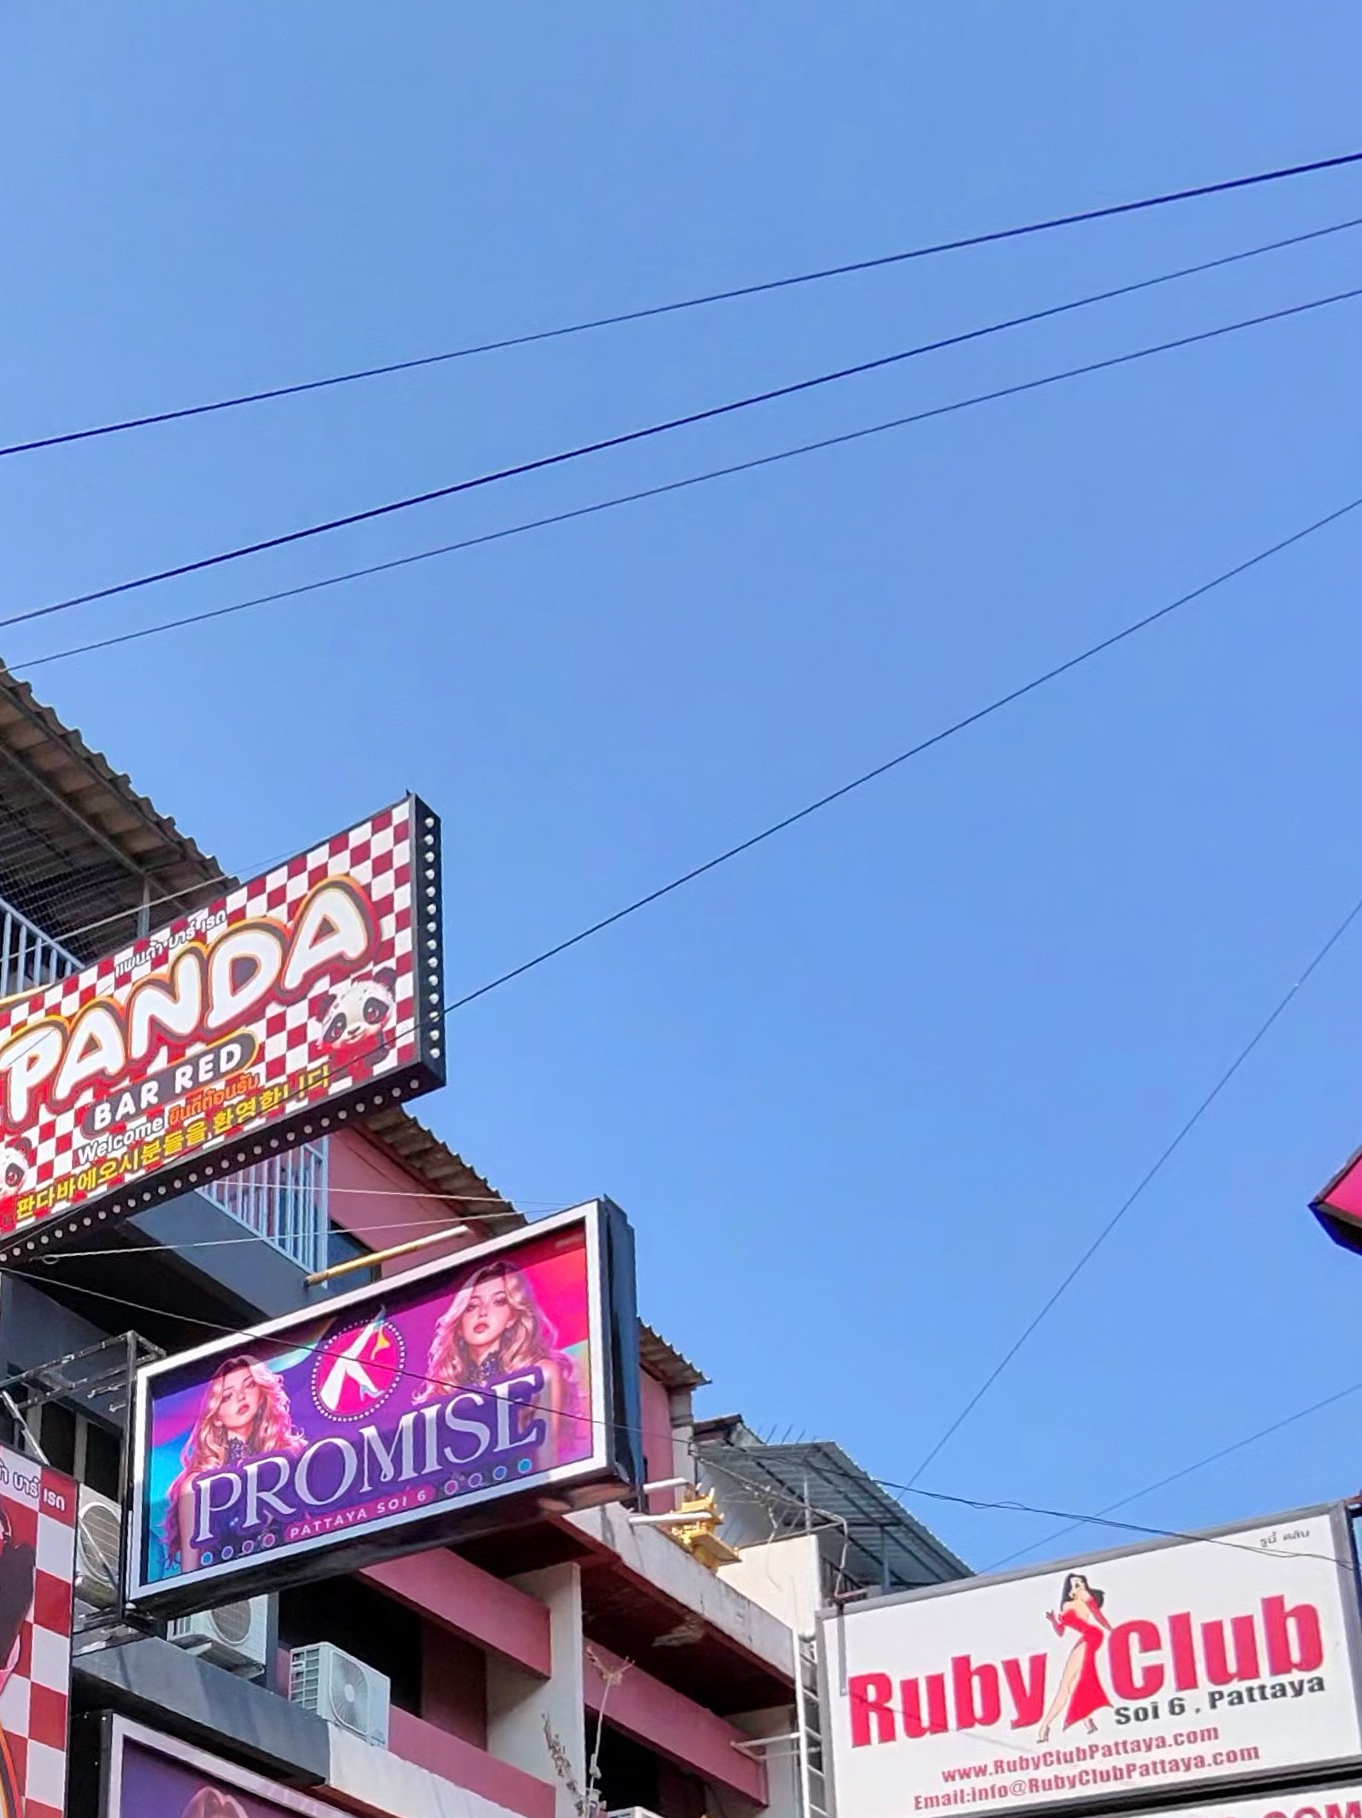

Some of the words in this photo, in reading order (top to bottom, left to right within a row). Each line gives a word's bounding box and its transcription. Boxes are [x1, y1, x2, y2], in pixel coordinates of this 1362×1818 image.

[93, 1081, 159, 1131] BAR
[174, 1042, 242, 1094] RED
[77, 1115, 165, 1166] Welcome
[194, 1374, 539, 1543] PROMISE
[289, 1506, 367, 1539] PATTAYA
[376, 1498, 408, 1517] SOI
[416, 1490, 427, 1504] 6
[847, 1653, 1048, 1748] Ruby
[1107, 1593, 1325, 1702] Club
[1114, 1696, 1159, 1727] Soi
[1208, 1675, 1326, 1713] Pattaya
[941, 1726, 1220, 1784] www.RubyClubPattaya.com
